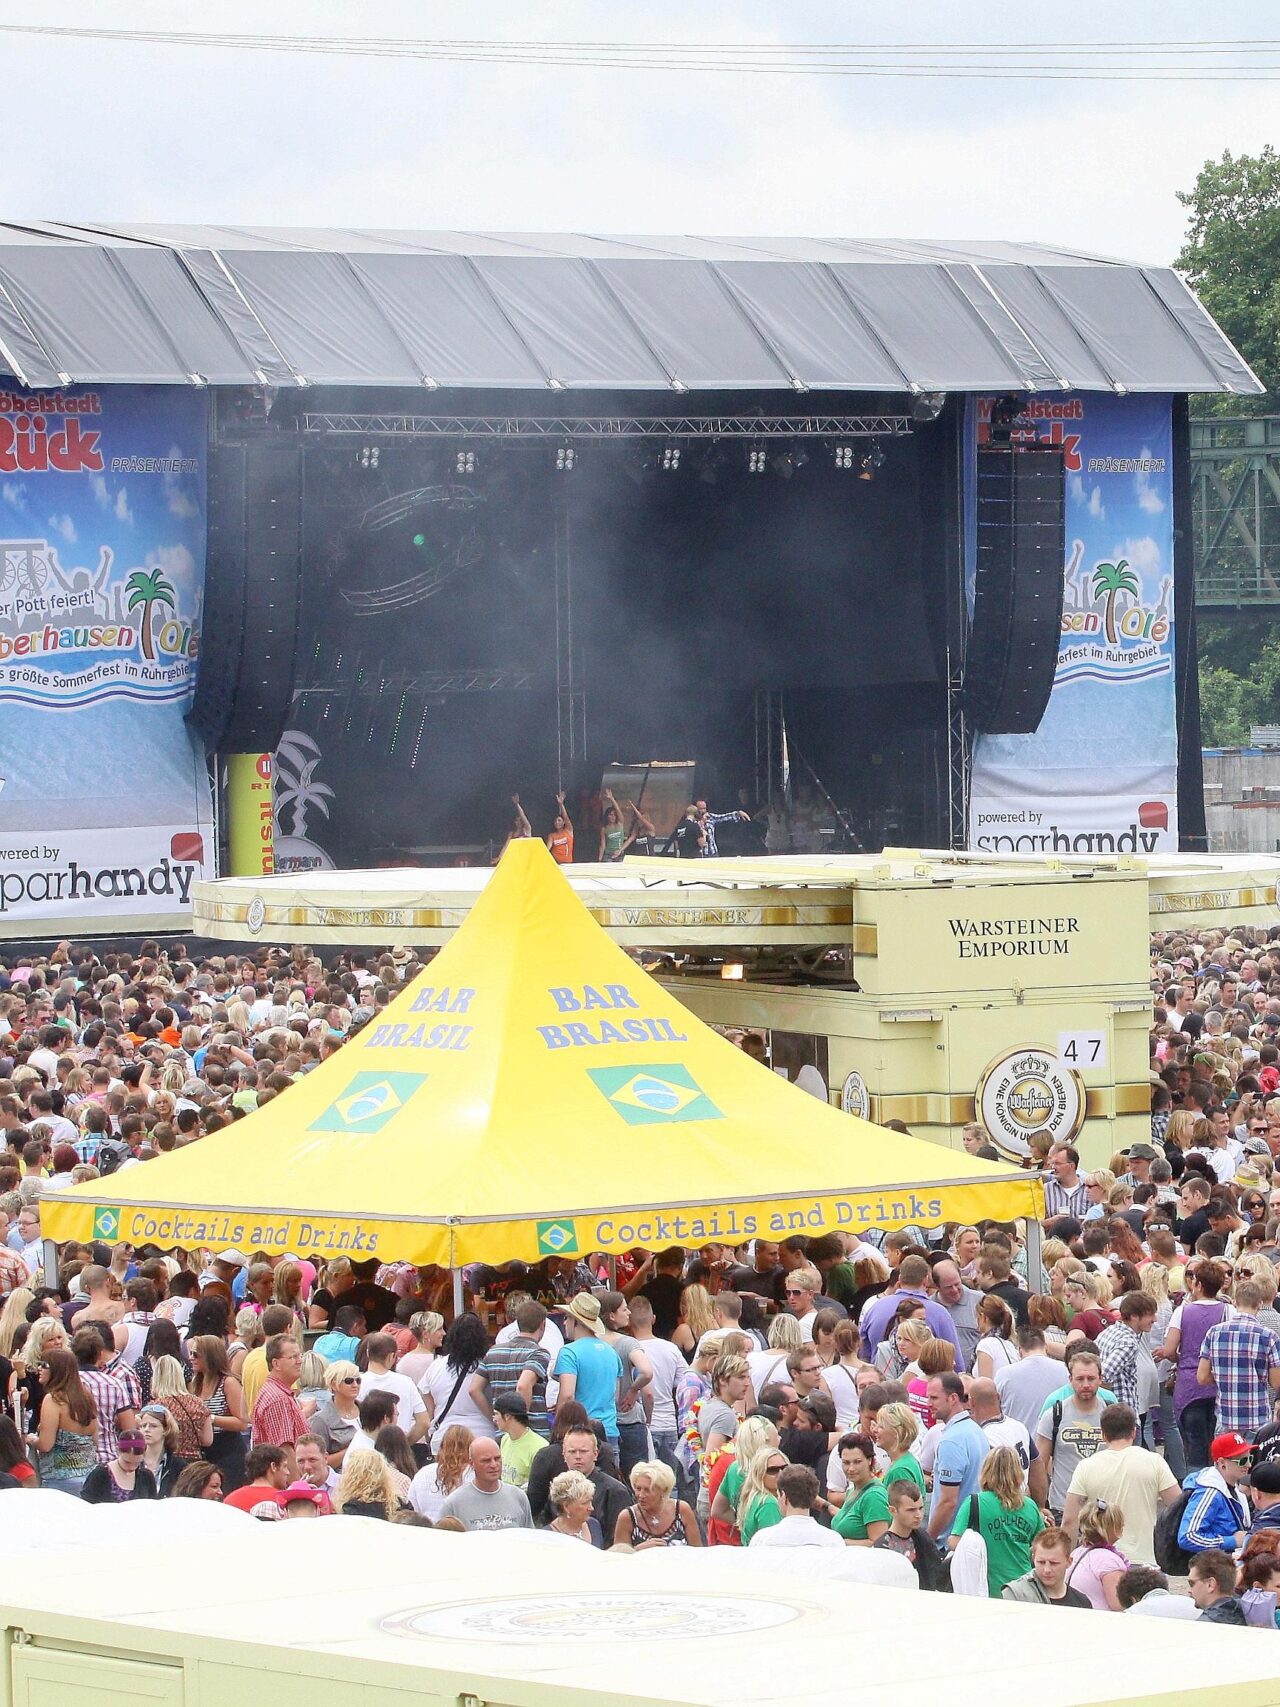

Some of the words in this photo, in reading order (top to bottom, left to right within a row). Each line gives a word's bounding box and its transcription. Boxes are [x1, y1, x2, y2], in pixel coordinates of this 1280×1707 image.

[1089, 457, 1165, 473] PRÄSENTIERT:
[16, 597, 46, 613] Pott
[50, 589, 95, 609] feiert!
[1121, 608, 1168, 642] Olé
[1091, 646, 1103, 659] im
[1105, 645, 1157, 663] Ruhrgebiet
[9, 668, 50, 686] größte
[53, 663, 120, 688] Sommerfest
[124, 662, 138, 677] im
[978, 811, 1026, 826] powered
[1029, 811, 1042, 824] by
[43, 846, 60, 862] by
[948, 917, 1080, 939] WARSTEINER
[958, 939, 1070, 958] EMPORIUM
[409, 986, 475, 1014] BAR
[547, 983, 640, 1013] BAR
[364, 1022, 475, 1051] BRASIL
[535, 1017, 688, 1050] BRASIL
[996, 1077, 1011, 1100] EINE
[1050, 1075, 1066, 1110] BIEREN
[995, 1102, 1019, 1138] KÖNIGIN
[1048, 1112, 1064, 1131] DEN
[131, 1213, 245, 1244] Cocktails
[249, 1219, 289, 1245] and
[297, 1222, 379, 1252] Drinks
[595, 1209, 758, 1246] Cocktails
[769, 1202, 826, 1232] and
[835, 1194, 943, 1225] Drinks
